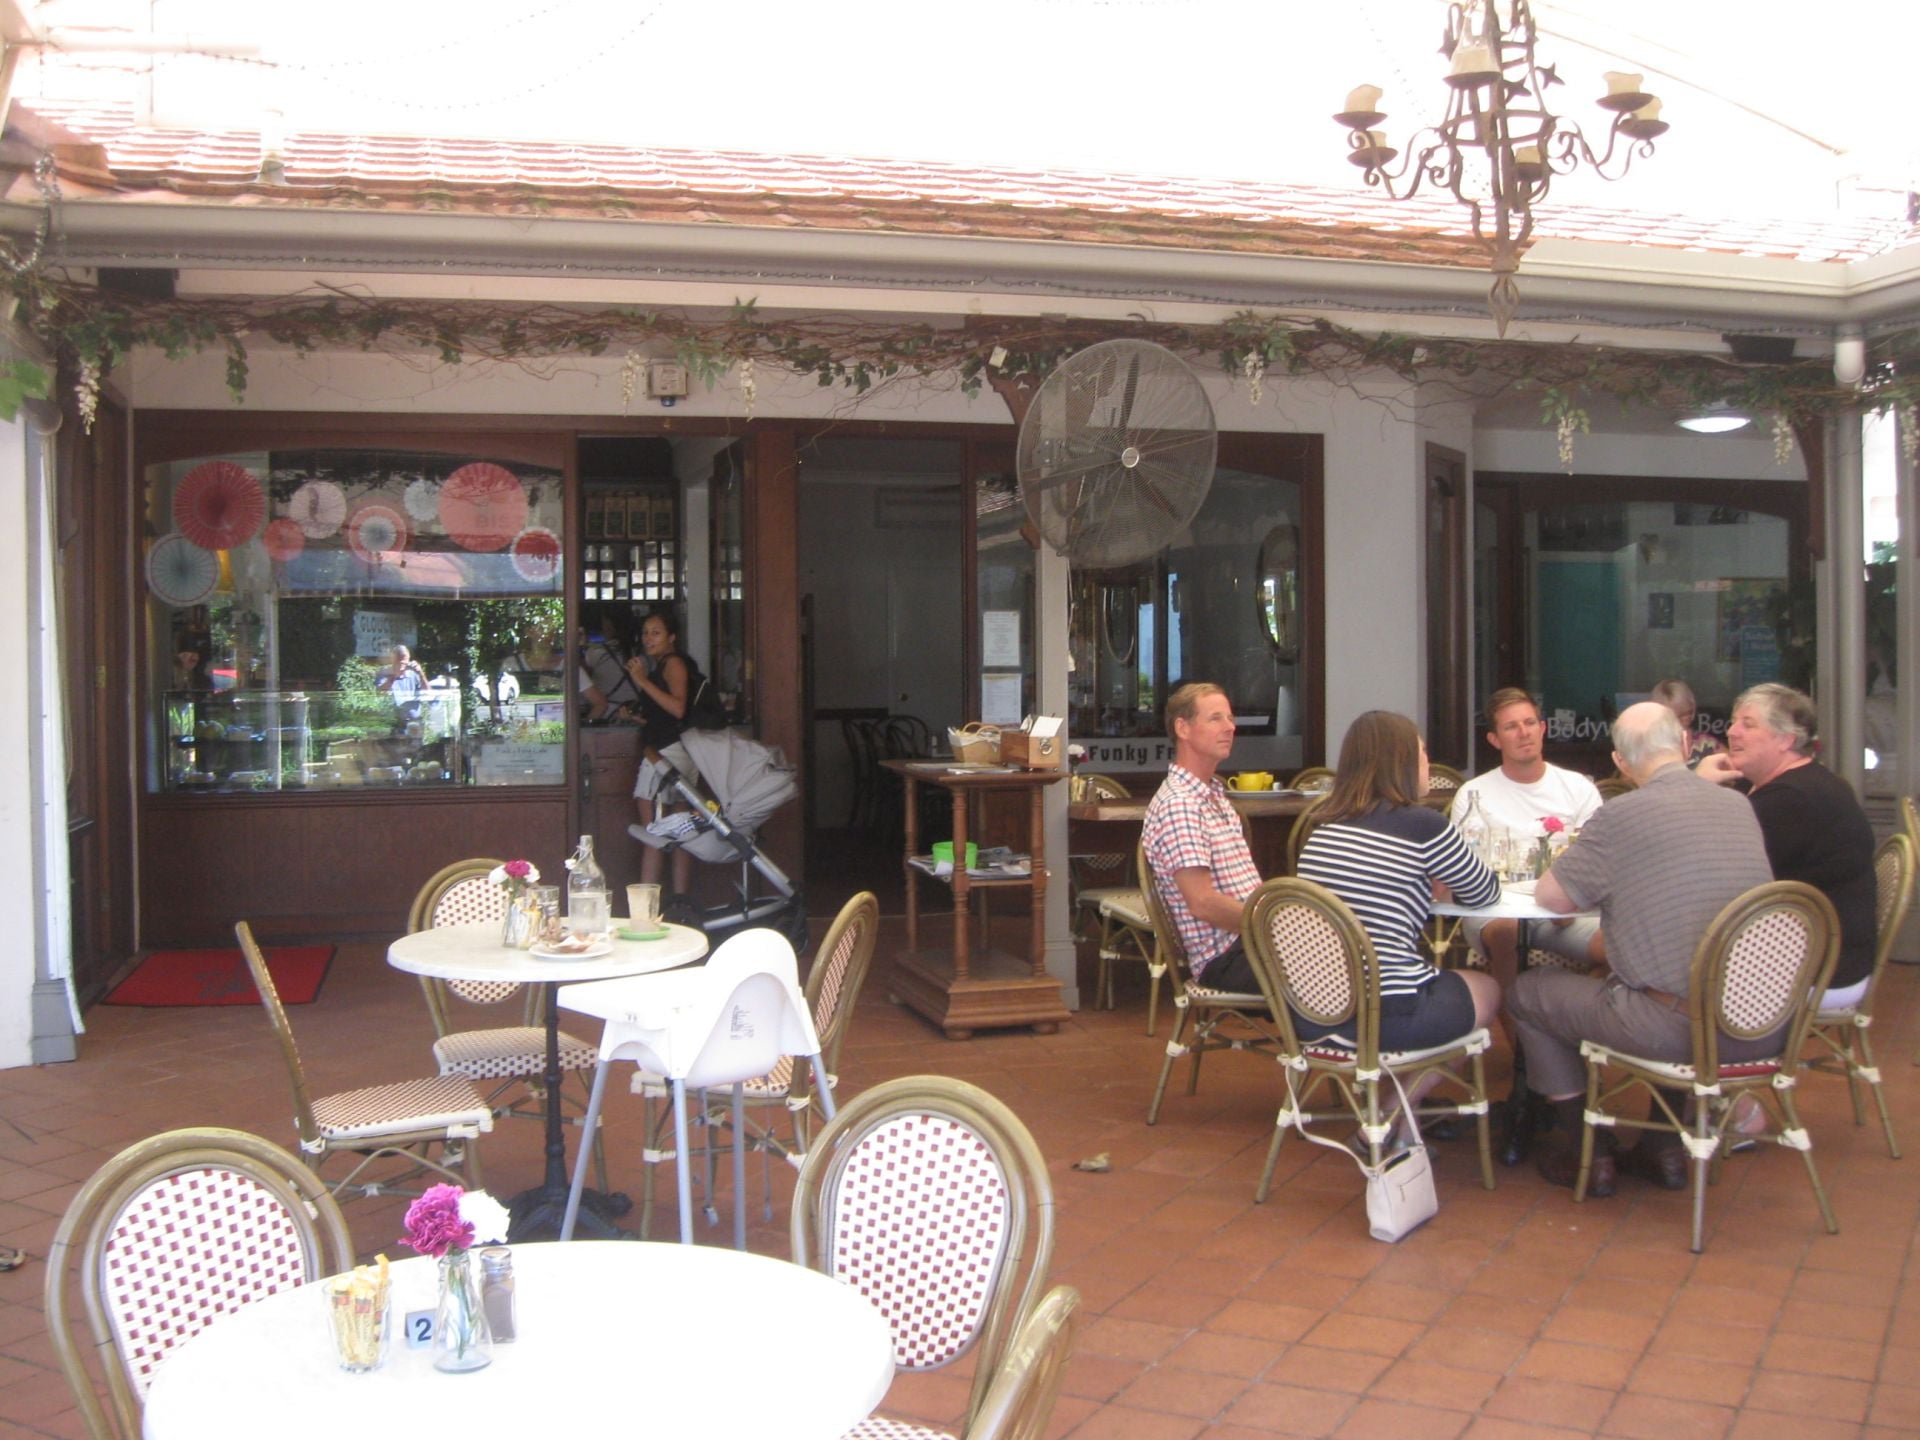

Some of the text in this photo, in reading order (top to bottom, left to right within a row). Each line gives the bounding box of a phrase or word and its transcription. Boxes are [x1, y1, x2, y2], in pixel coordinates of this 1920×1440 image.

[1088, 744, 1176, 765] Funky Fr
[415, 1318, 431, 1342] 2
